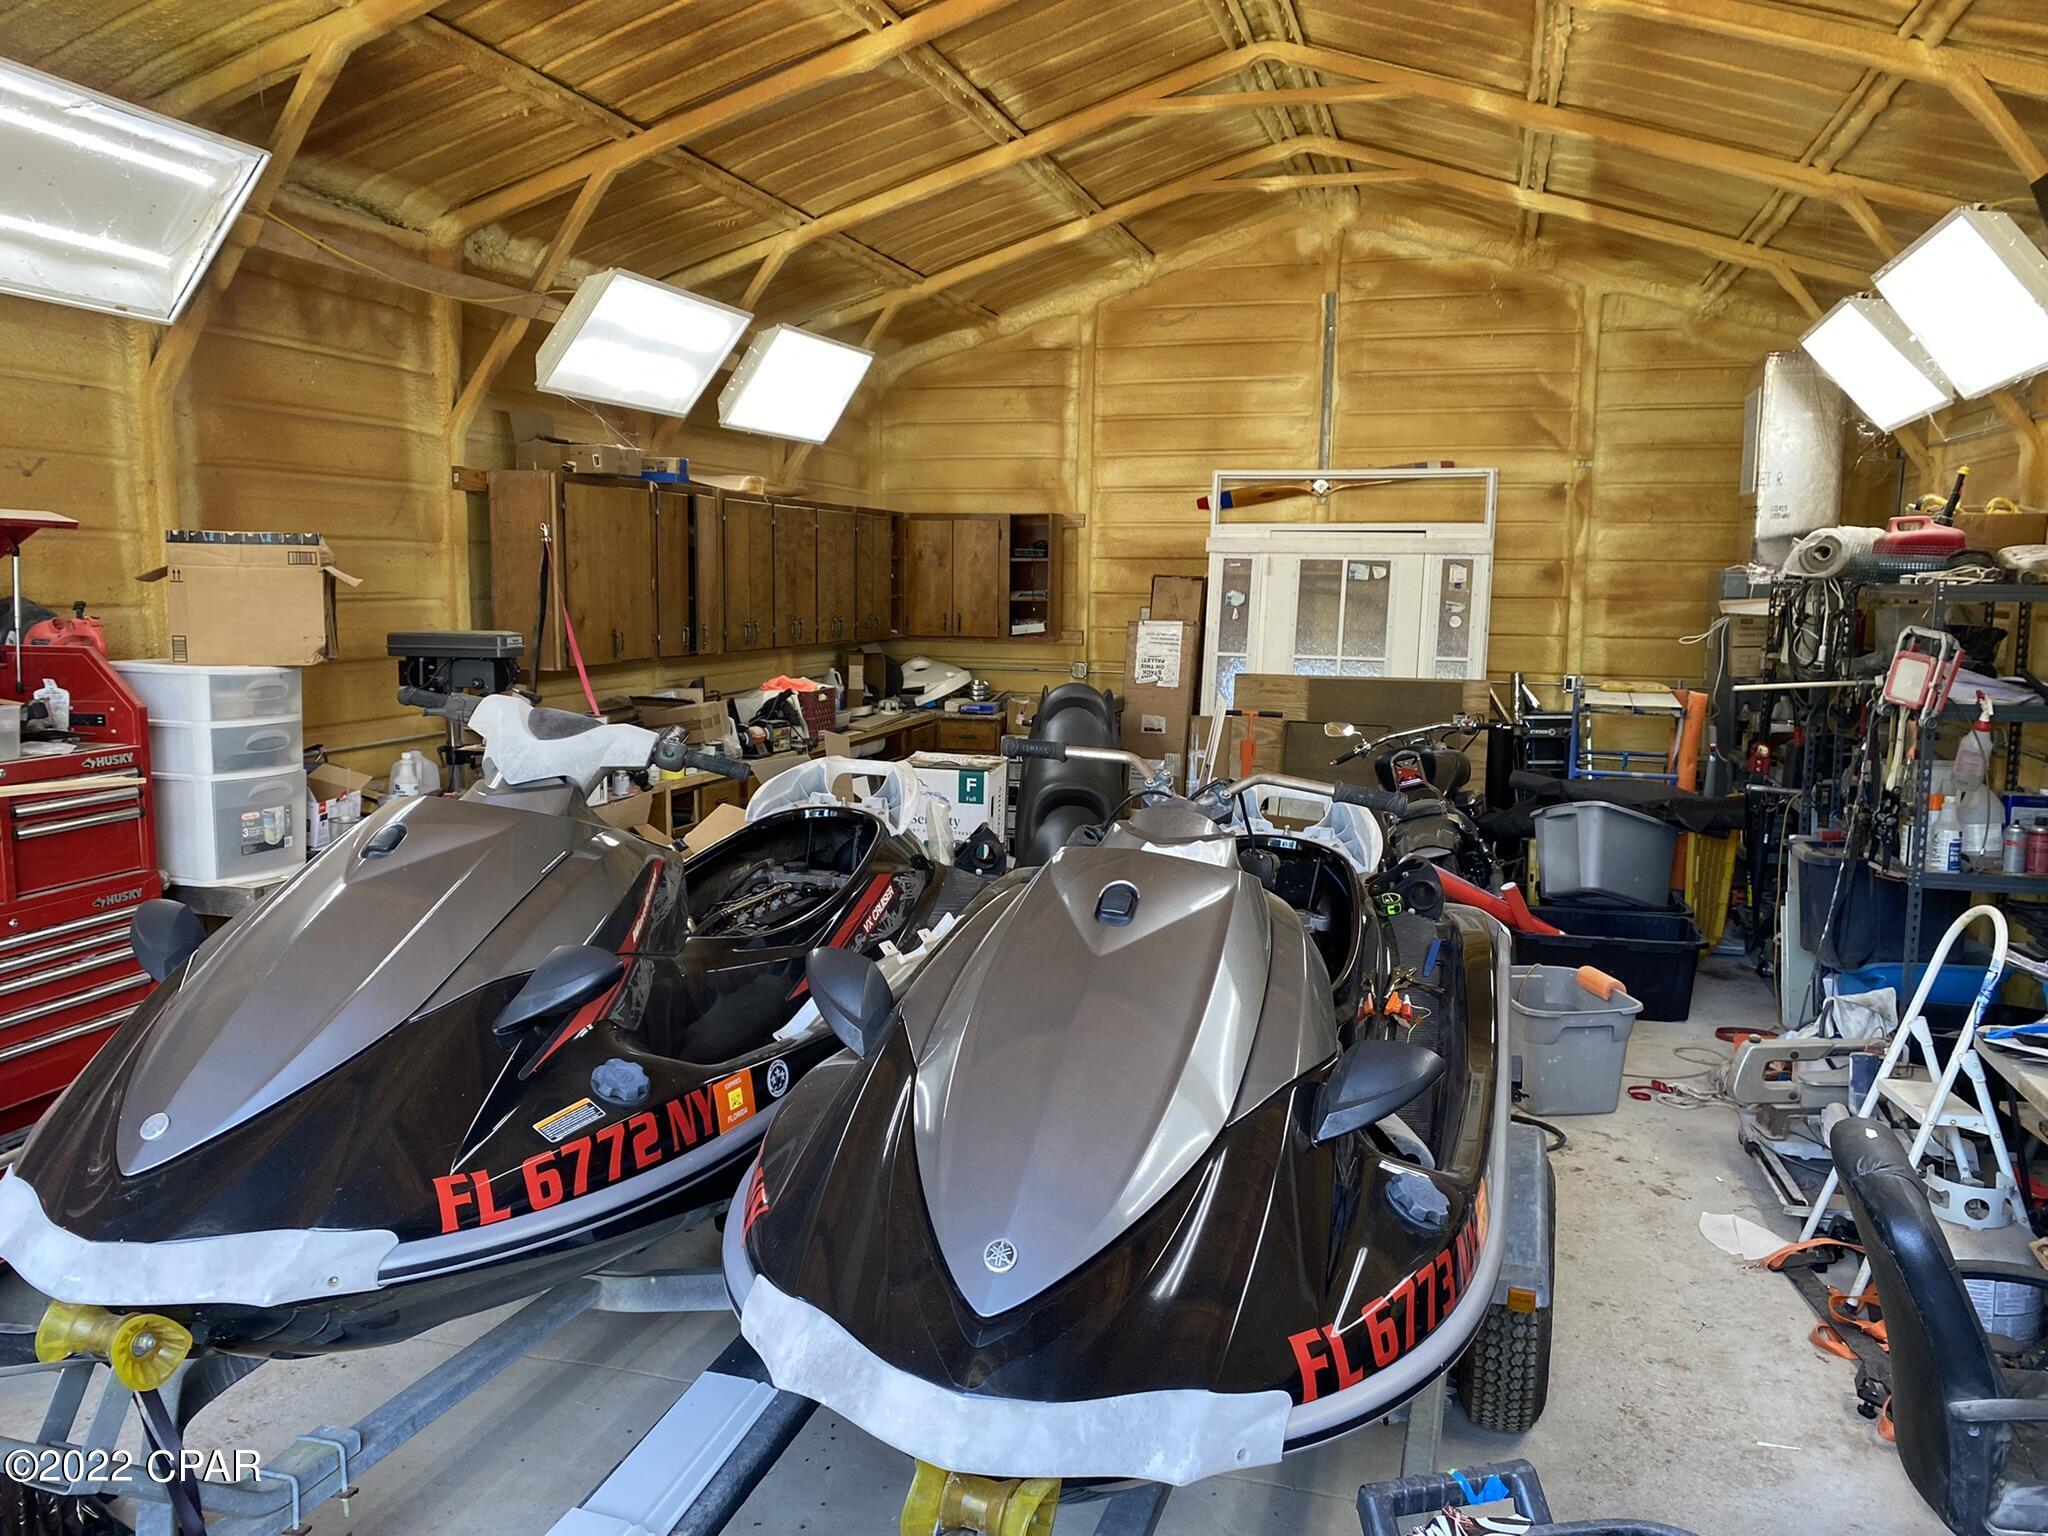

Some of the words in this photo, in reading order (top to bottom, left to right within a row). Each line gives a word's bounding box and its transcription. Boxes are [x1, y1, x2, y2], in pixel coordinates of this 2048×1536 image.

[96, 752, 134, 767] HUSKY
[966, 777, 977, 792] F
[242, 827, 249, 838] 3
[106, 887, 143, 905] HUSKY
[863, 915, 874, 933] VX
[872, 885, 894, 921] CRUISER
[727, 1107, 748, 1124] FLORIDA
[432, 1168, 512, 1234] FL
[522, 1110, 663, 1211] 6772
[666, 1083, 714, 1153] NY
[1288, 1322, 1365, 1404] FL
[1361, 1248, 1457, 1368] 6773
